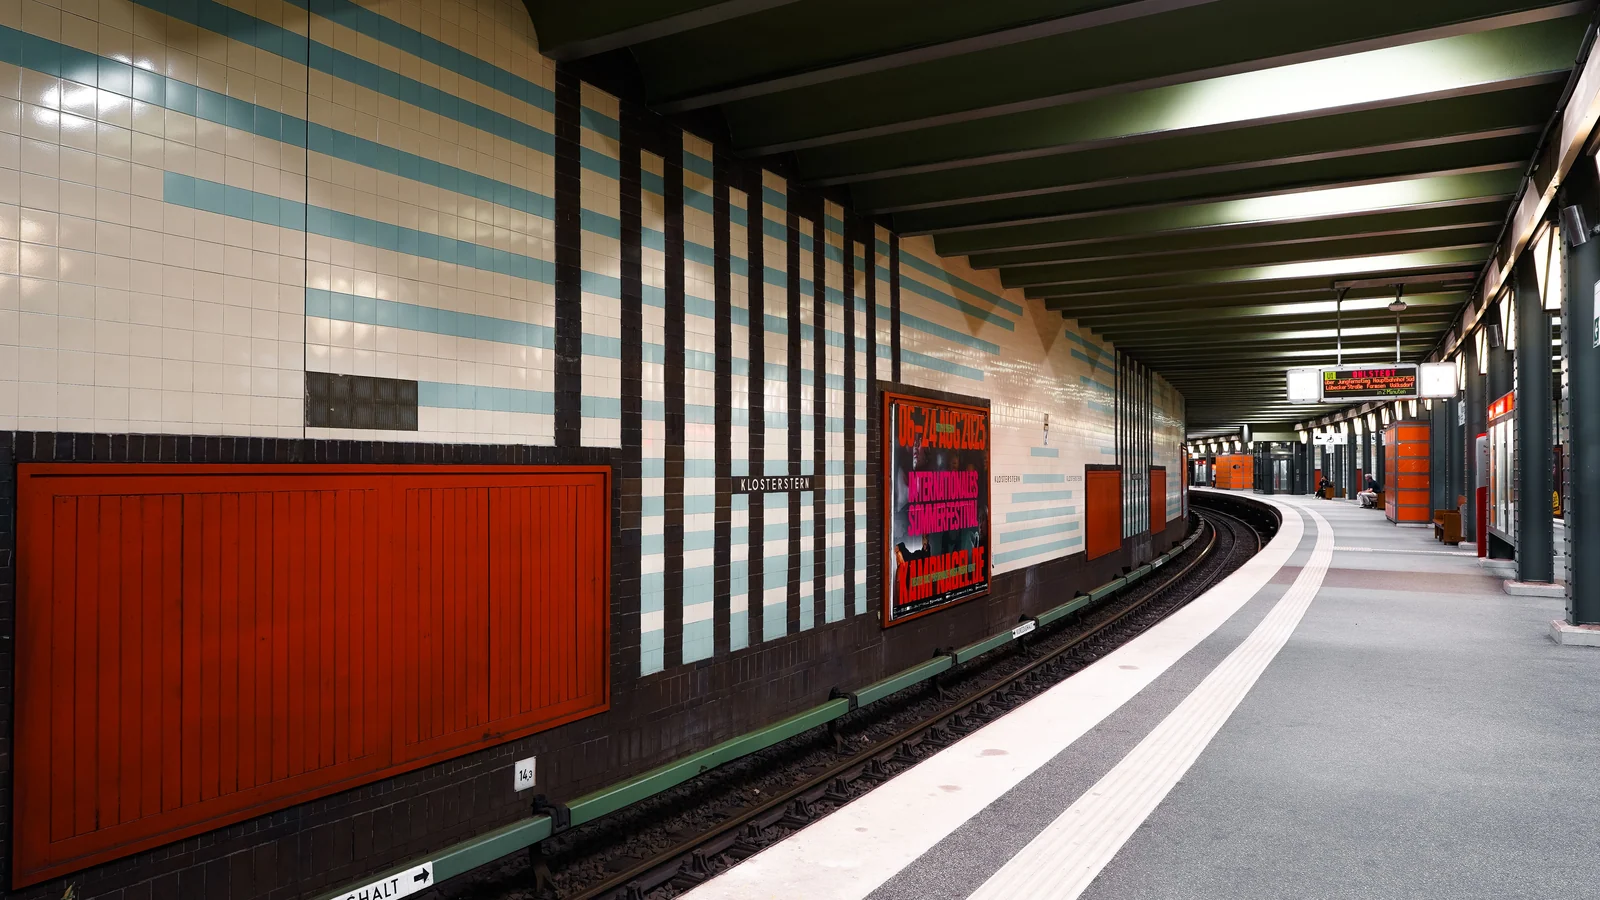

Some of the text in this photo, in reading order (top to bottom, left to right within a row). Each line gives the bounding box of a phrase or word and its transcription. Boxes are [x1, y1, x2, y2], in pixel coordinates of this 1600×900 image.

[1352, 370, 1396, 378] OHLSTEDT
[939, 409, 961, 450] AUG
[961, 411, 986, 451] 2025
[740, 478, 810, 491] KLOSTERSTERN
[907, 470, 979, 503] INTERNATIONALES
[907, 499, 979, 537] SOMMERFESTIVAL
[899, 546, 985, 606] KAMPNAGEL.DE
[519, 768, 533, 782] 14,3
